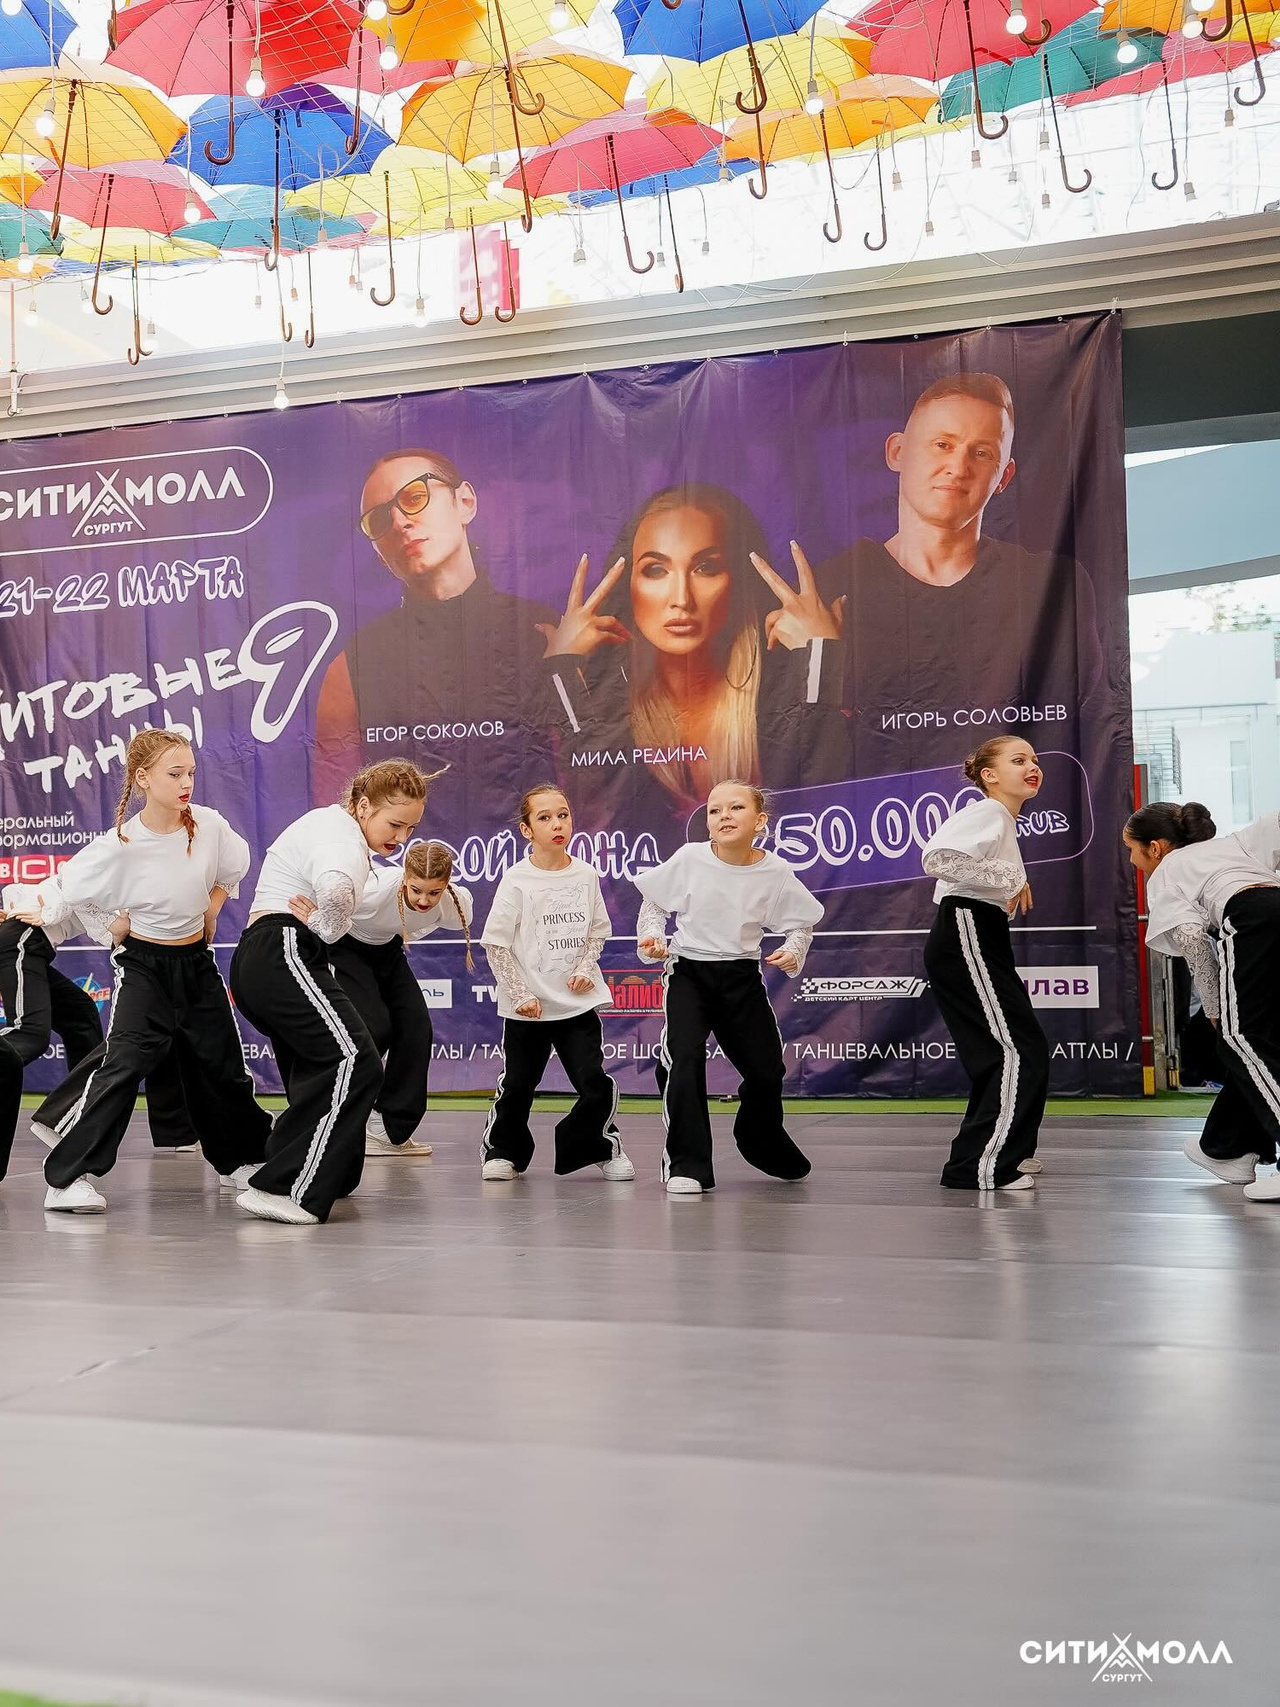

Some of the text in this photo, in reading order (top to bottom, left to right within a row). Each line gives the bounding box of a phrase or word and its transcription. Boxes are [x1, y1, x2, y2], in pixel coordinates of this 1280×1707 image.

[125, 466, 245, 507] МОЛЛ
[83, 520, 134, 537] СУРГУТ
[118, 556, 245, 609] МАРТА
[881, 703, 1068, 730] ИГОРЬ СОЛОВЬЕВ
[366, 720, 505, 743] ЕГОР СОКОЛОВ
[24, 706, 204, 794] ТАНЫ
[571, 745, 708, 767] МИЛА РЕДИНА
[1015, 810, 1070, 838] RUB
[525, 829, 663, 881] ОНД
[542, 911, 586, 926] PRINCESS
[548, 937, 586, 951] STORIES
[820, 980, 909, 991] ФОРСАЖ
[793, 1043, 956, 1062] ТАНЦЕВАЛЬНОЕ
[1050, 1042, 1118, 1060] АТТЛЫ
